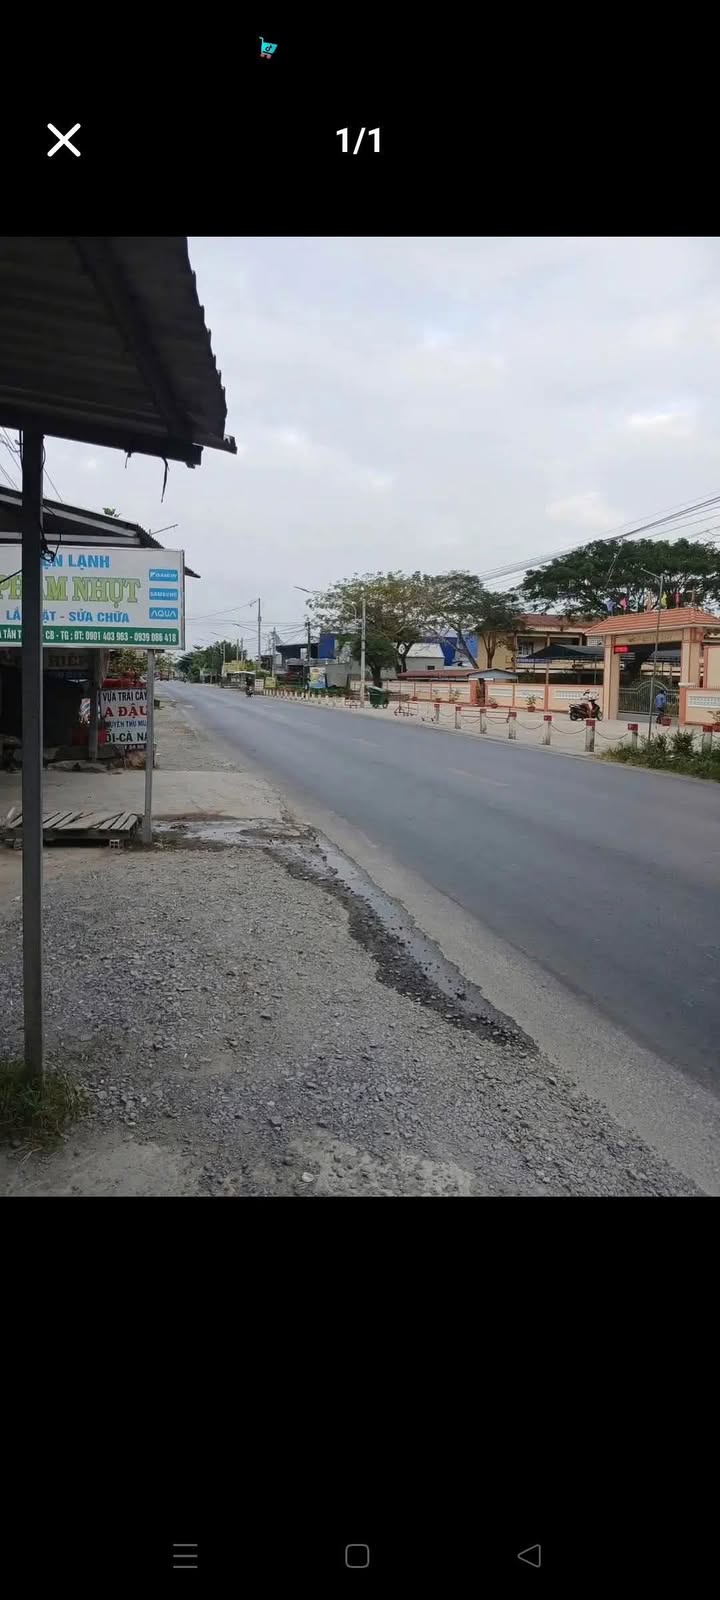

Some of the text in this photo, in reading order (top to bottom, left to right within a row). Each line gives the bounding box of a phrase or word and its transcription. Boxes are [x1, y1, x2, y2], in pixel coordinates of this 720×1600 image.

[69, 554, 110, 570] LẠNH
[0, 575, 68, 601] PHM
[69, 608, 93, 622] SỬA
[97, 610, 129, 623] CHỮA
[151, 609, 177, 618] AQUA
[103, 631, 115, 641] 403
